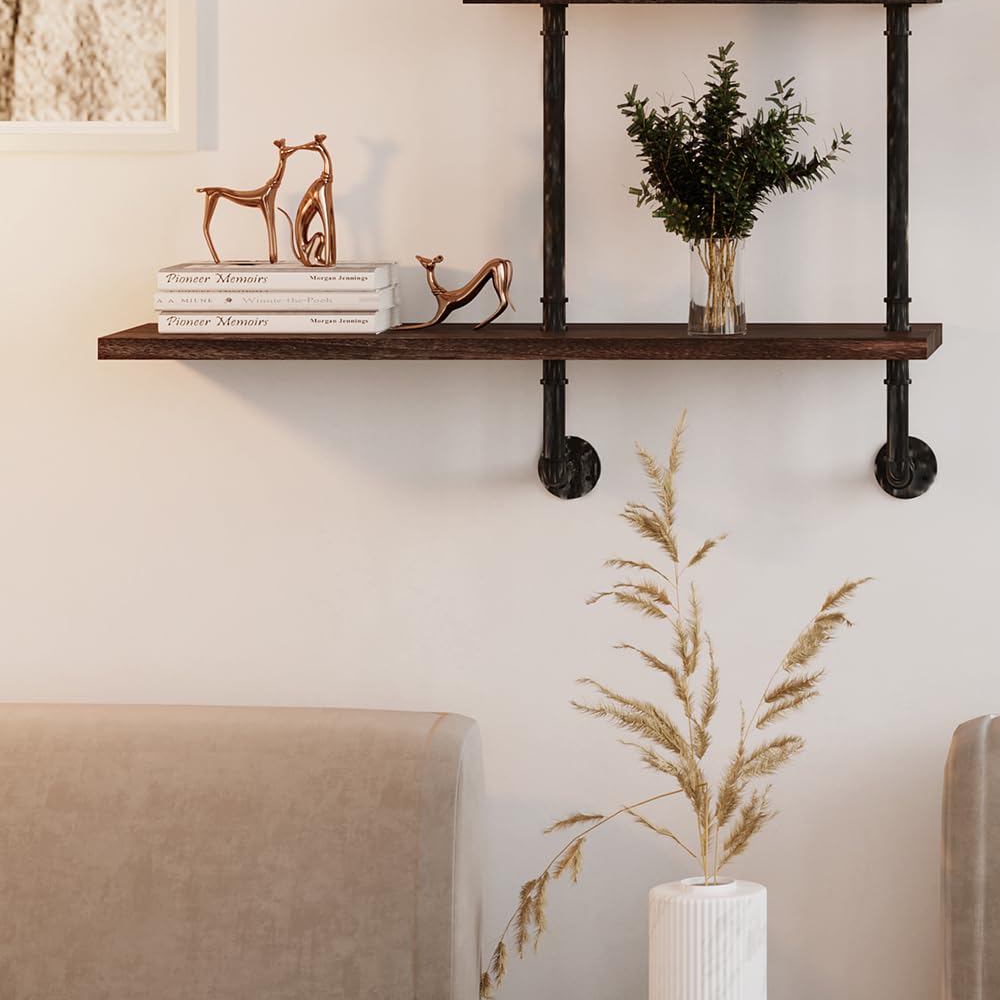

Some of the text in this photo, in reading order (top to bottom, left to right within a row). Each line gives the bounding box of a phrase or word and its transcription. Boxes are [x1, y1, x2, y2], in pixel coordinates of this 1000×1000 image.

[165, 272, 211, 285] Pioneer
[215, 272, 269, 284] Memoirs
[165, 315, 212, 328] Pioneer
[215, 315, 269, 327] Memoirs
